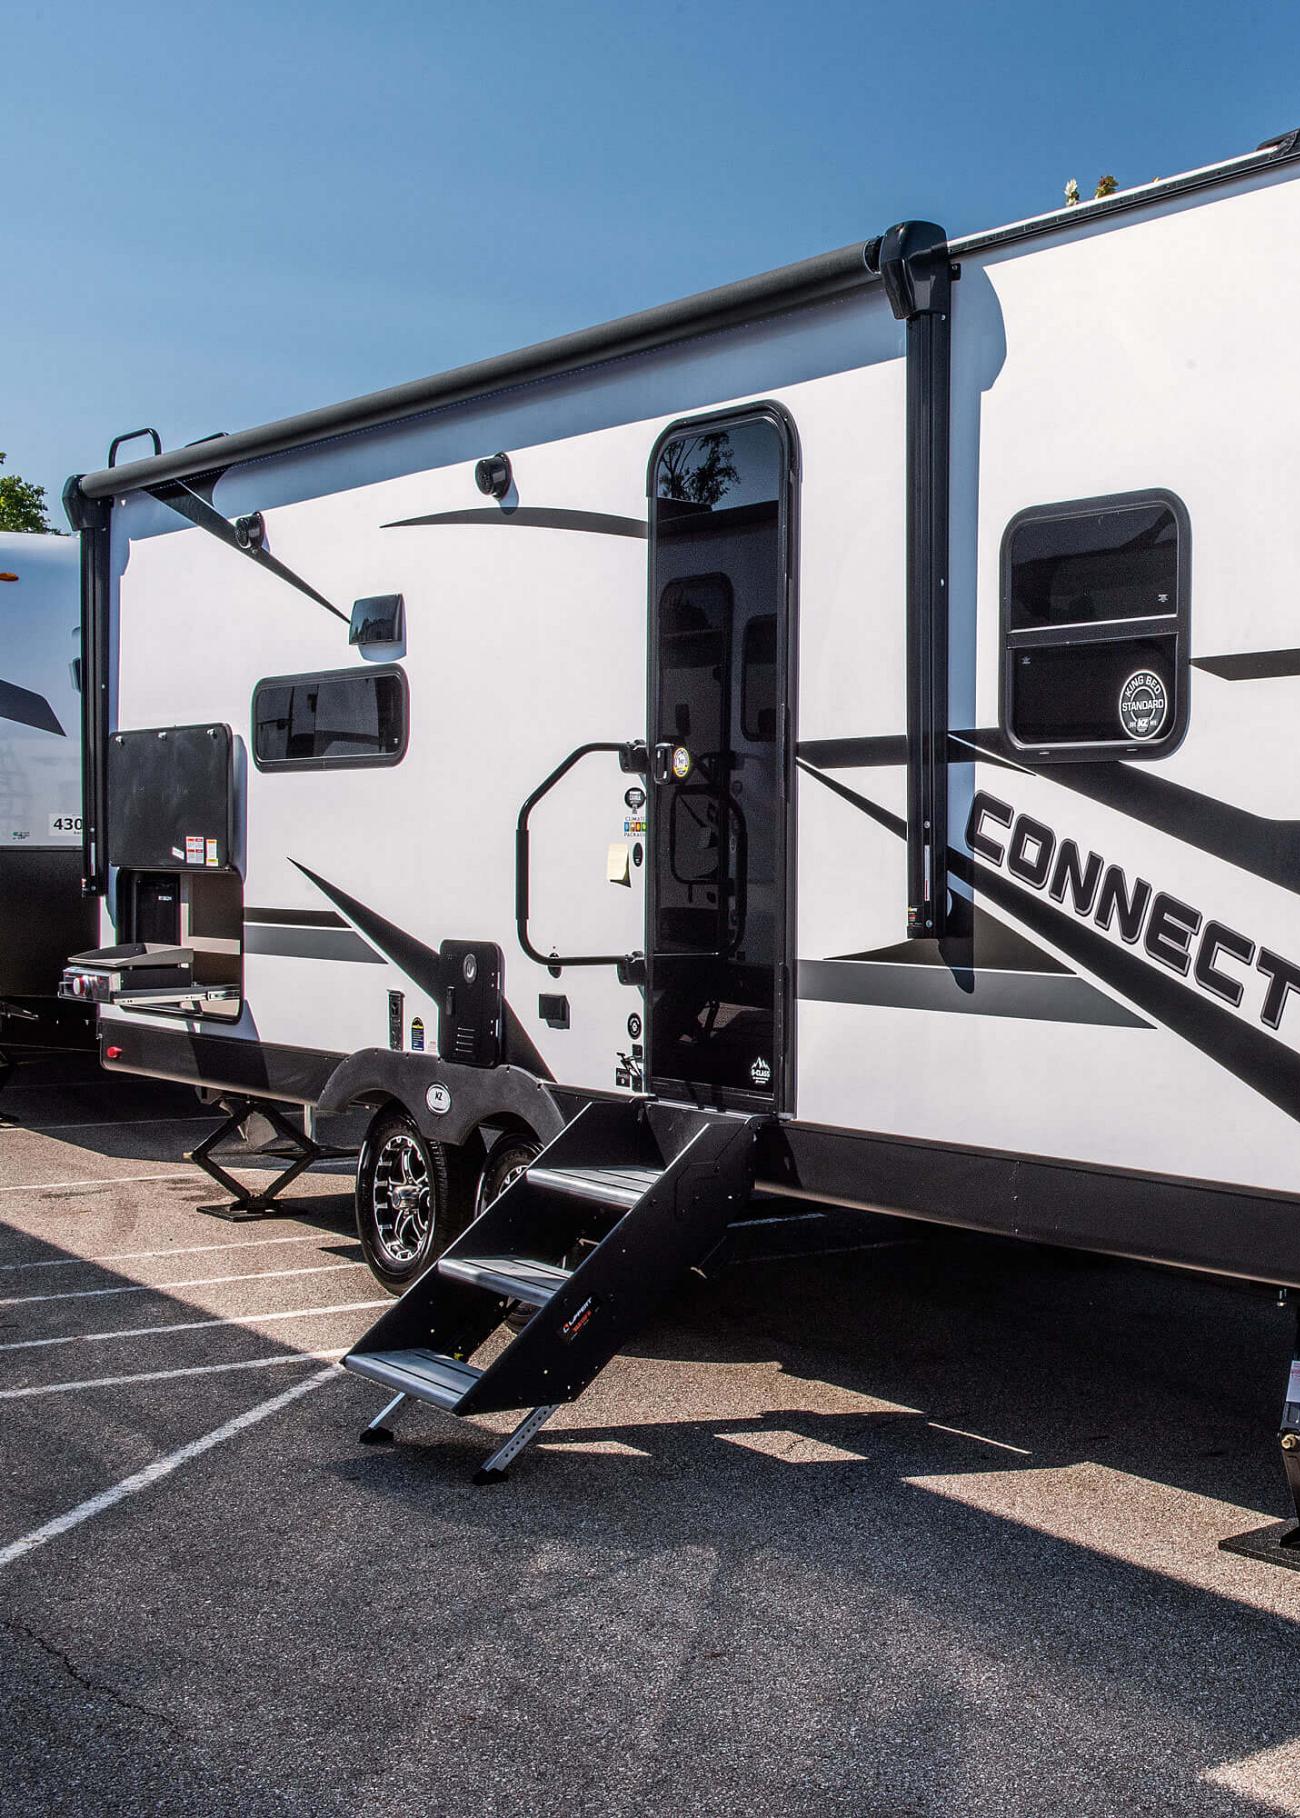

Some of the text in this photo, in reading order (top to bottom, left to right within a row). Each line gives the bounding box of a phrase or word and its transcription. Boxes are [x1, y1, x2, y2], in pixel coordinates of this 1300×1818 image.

[1125, 675, 1162, 697] KING BED
[1122, 699, 1164, 712] STANDARD
